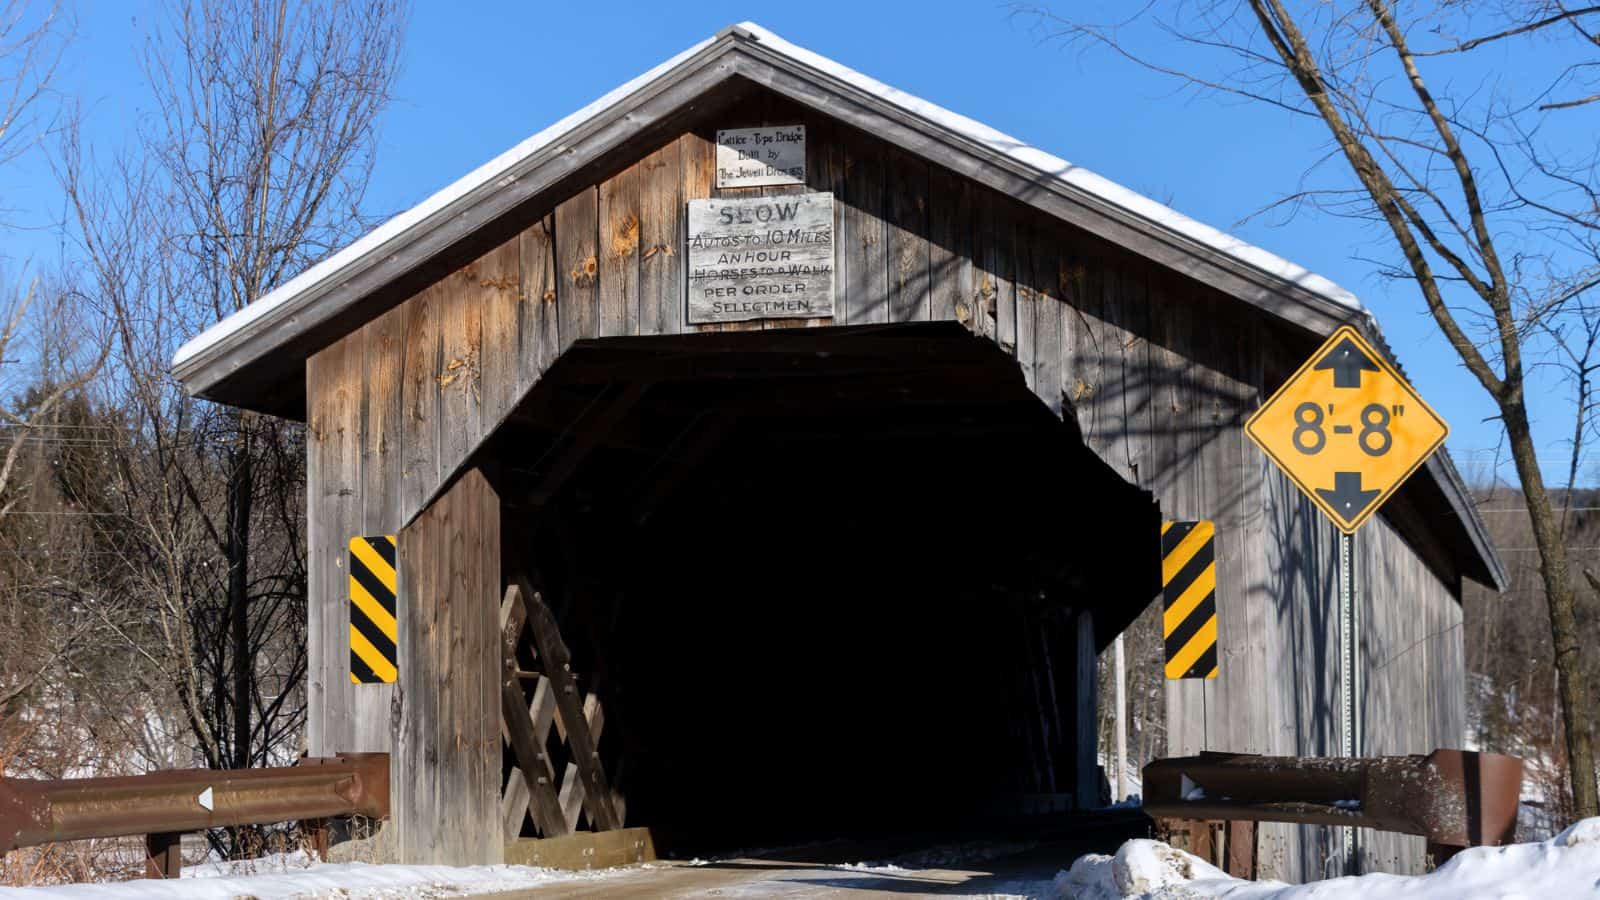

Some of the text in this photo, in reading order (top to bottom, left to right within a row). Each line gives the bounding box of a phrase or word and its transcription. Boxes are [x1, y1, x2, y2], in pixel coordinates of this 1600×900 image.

[768, 149, 779, 160] by
[719, 203, 799, 225] SLOW
[765, 229, 785, 246] 10
[717, 250, 792, 265] AN HOUR
[694, 267, 759, 283] HORSES
[704, 283, 806, 298] PER ORDER
[712, 299, 810, 314] SELECTMEN
